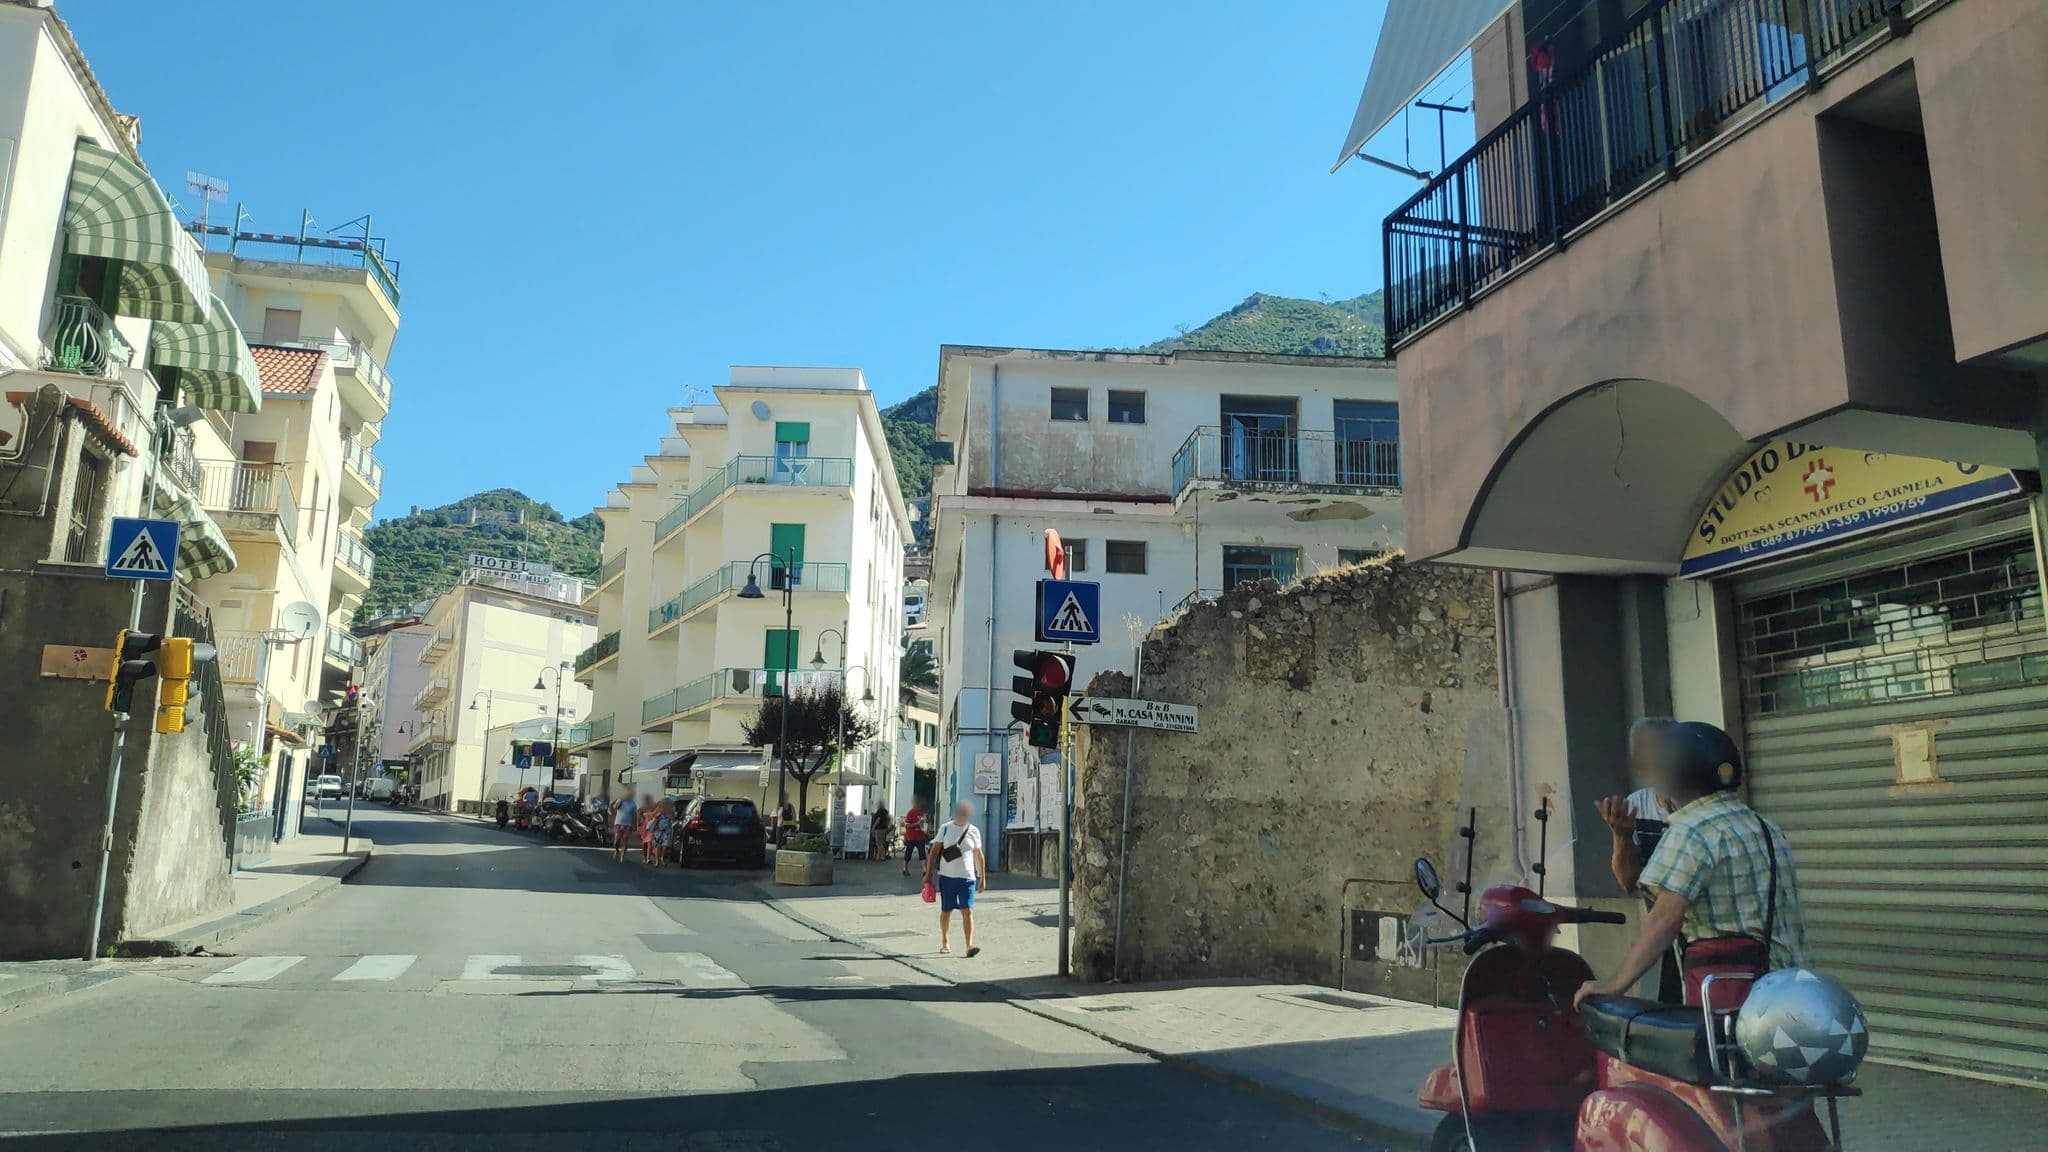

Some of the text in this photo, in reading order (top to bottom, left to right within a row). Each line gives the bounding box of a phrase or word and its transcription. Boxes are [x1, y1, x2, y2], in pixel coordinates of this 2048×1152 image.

[1699, 449, 1781, 544] STUDIO
[1777, 496, 1867, 530] SCANNAPIECO
[1873, 476, 1945, 502] CARMELA
[474, 556, 530, 572] HOTEL
[526, 575, 550, 584] MILO
[1146, 702, 1153, 711] B
[1163, 704, 1170, 712] B
[1115, 718, 1138, 726] GARAGE
[1116, 708, 1194, 725] M. CASA MANNINI
